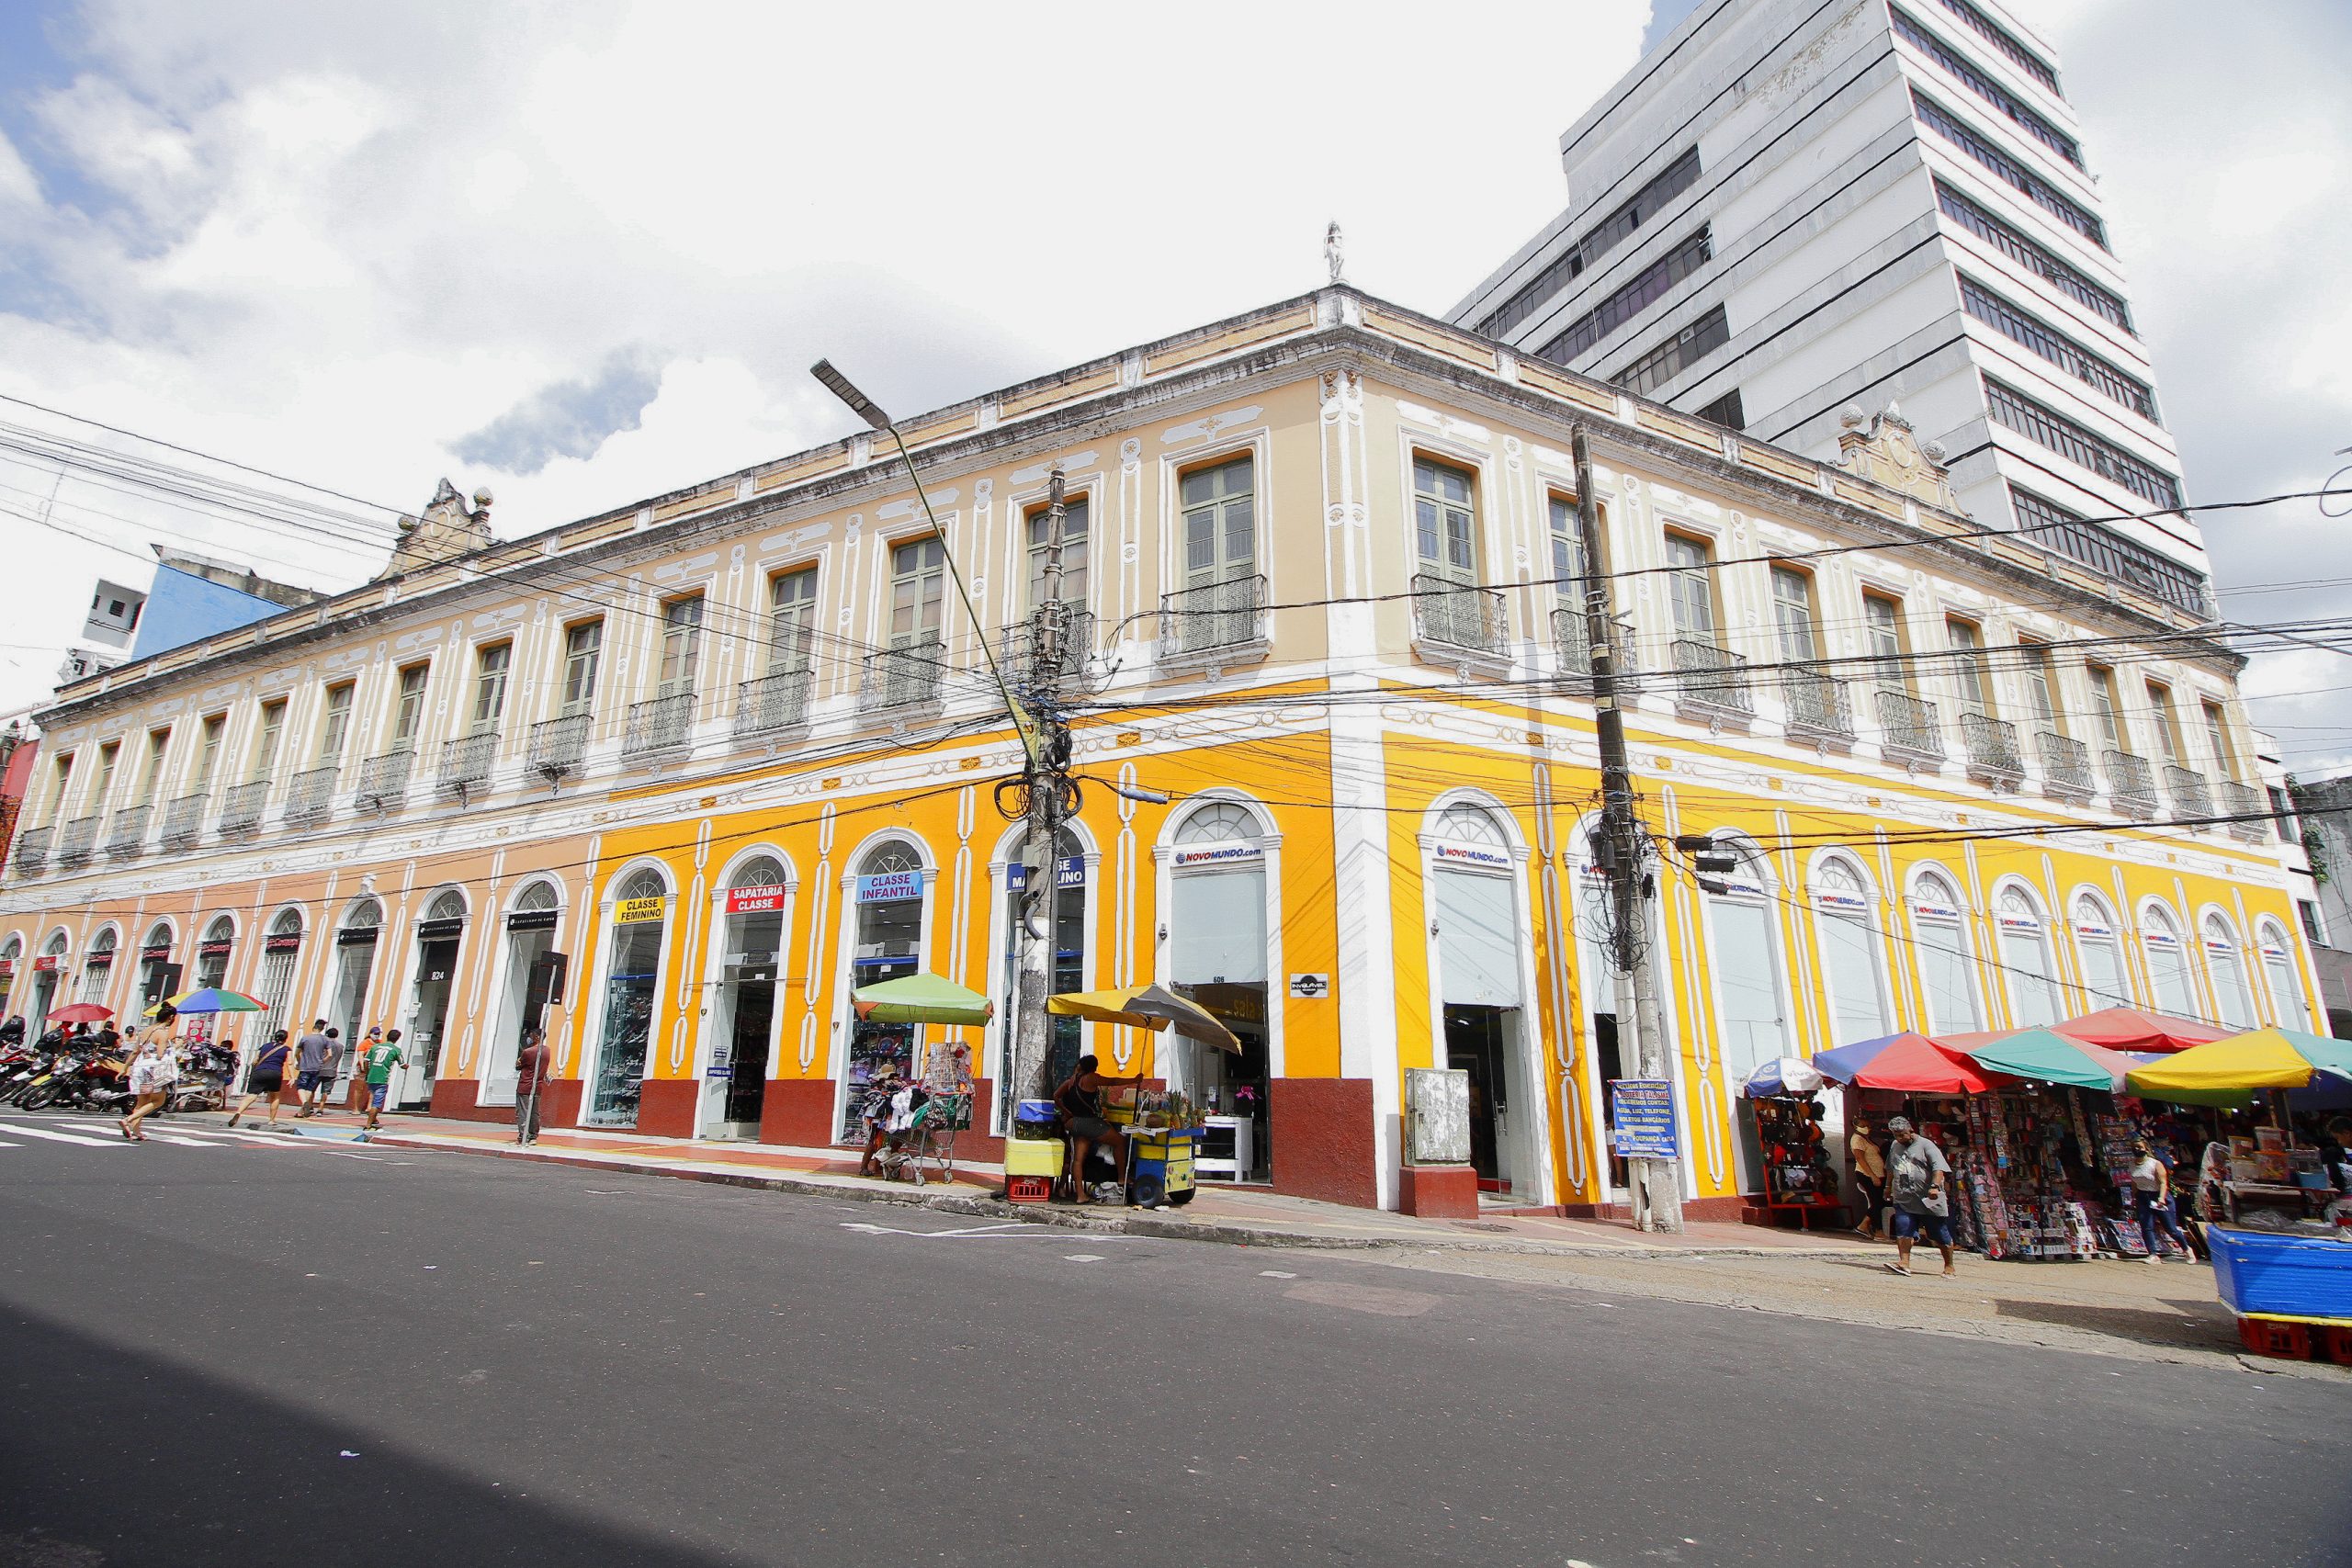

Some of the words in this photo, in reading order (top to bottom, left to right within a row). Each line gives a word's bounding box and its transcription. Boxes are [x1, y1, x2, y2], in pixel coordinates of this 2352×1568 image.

[1186, 848, 1261, 862] NOVOMUNDO.com
[1445, 848, 1509, 863] NOVOMUNDO.com
[871, 874, 910, 886] CLASSE
[733, 886, 783, 899] SAPATARIA
[862, 886, 918, 899] INFANTIL
[627, 899, 658, 910] CLASSE
[738, 898, 775, 910] CLASSE
[621, 908, 662, 920] FEMININO
[431, 971, 445, 981] 824
[374, 1048, 390, 1063] 10
